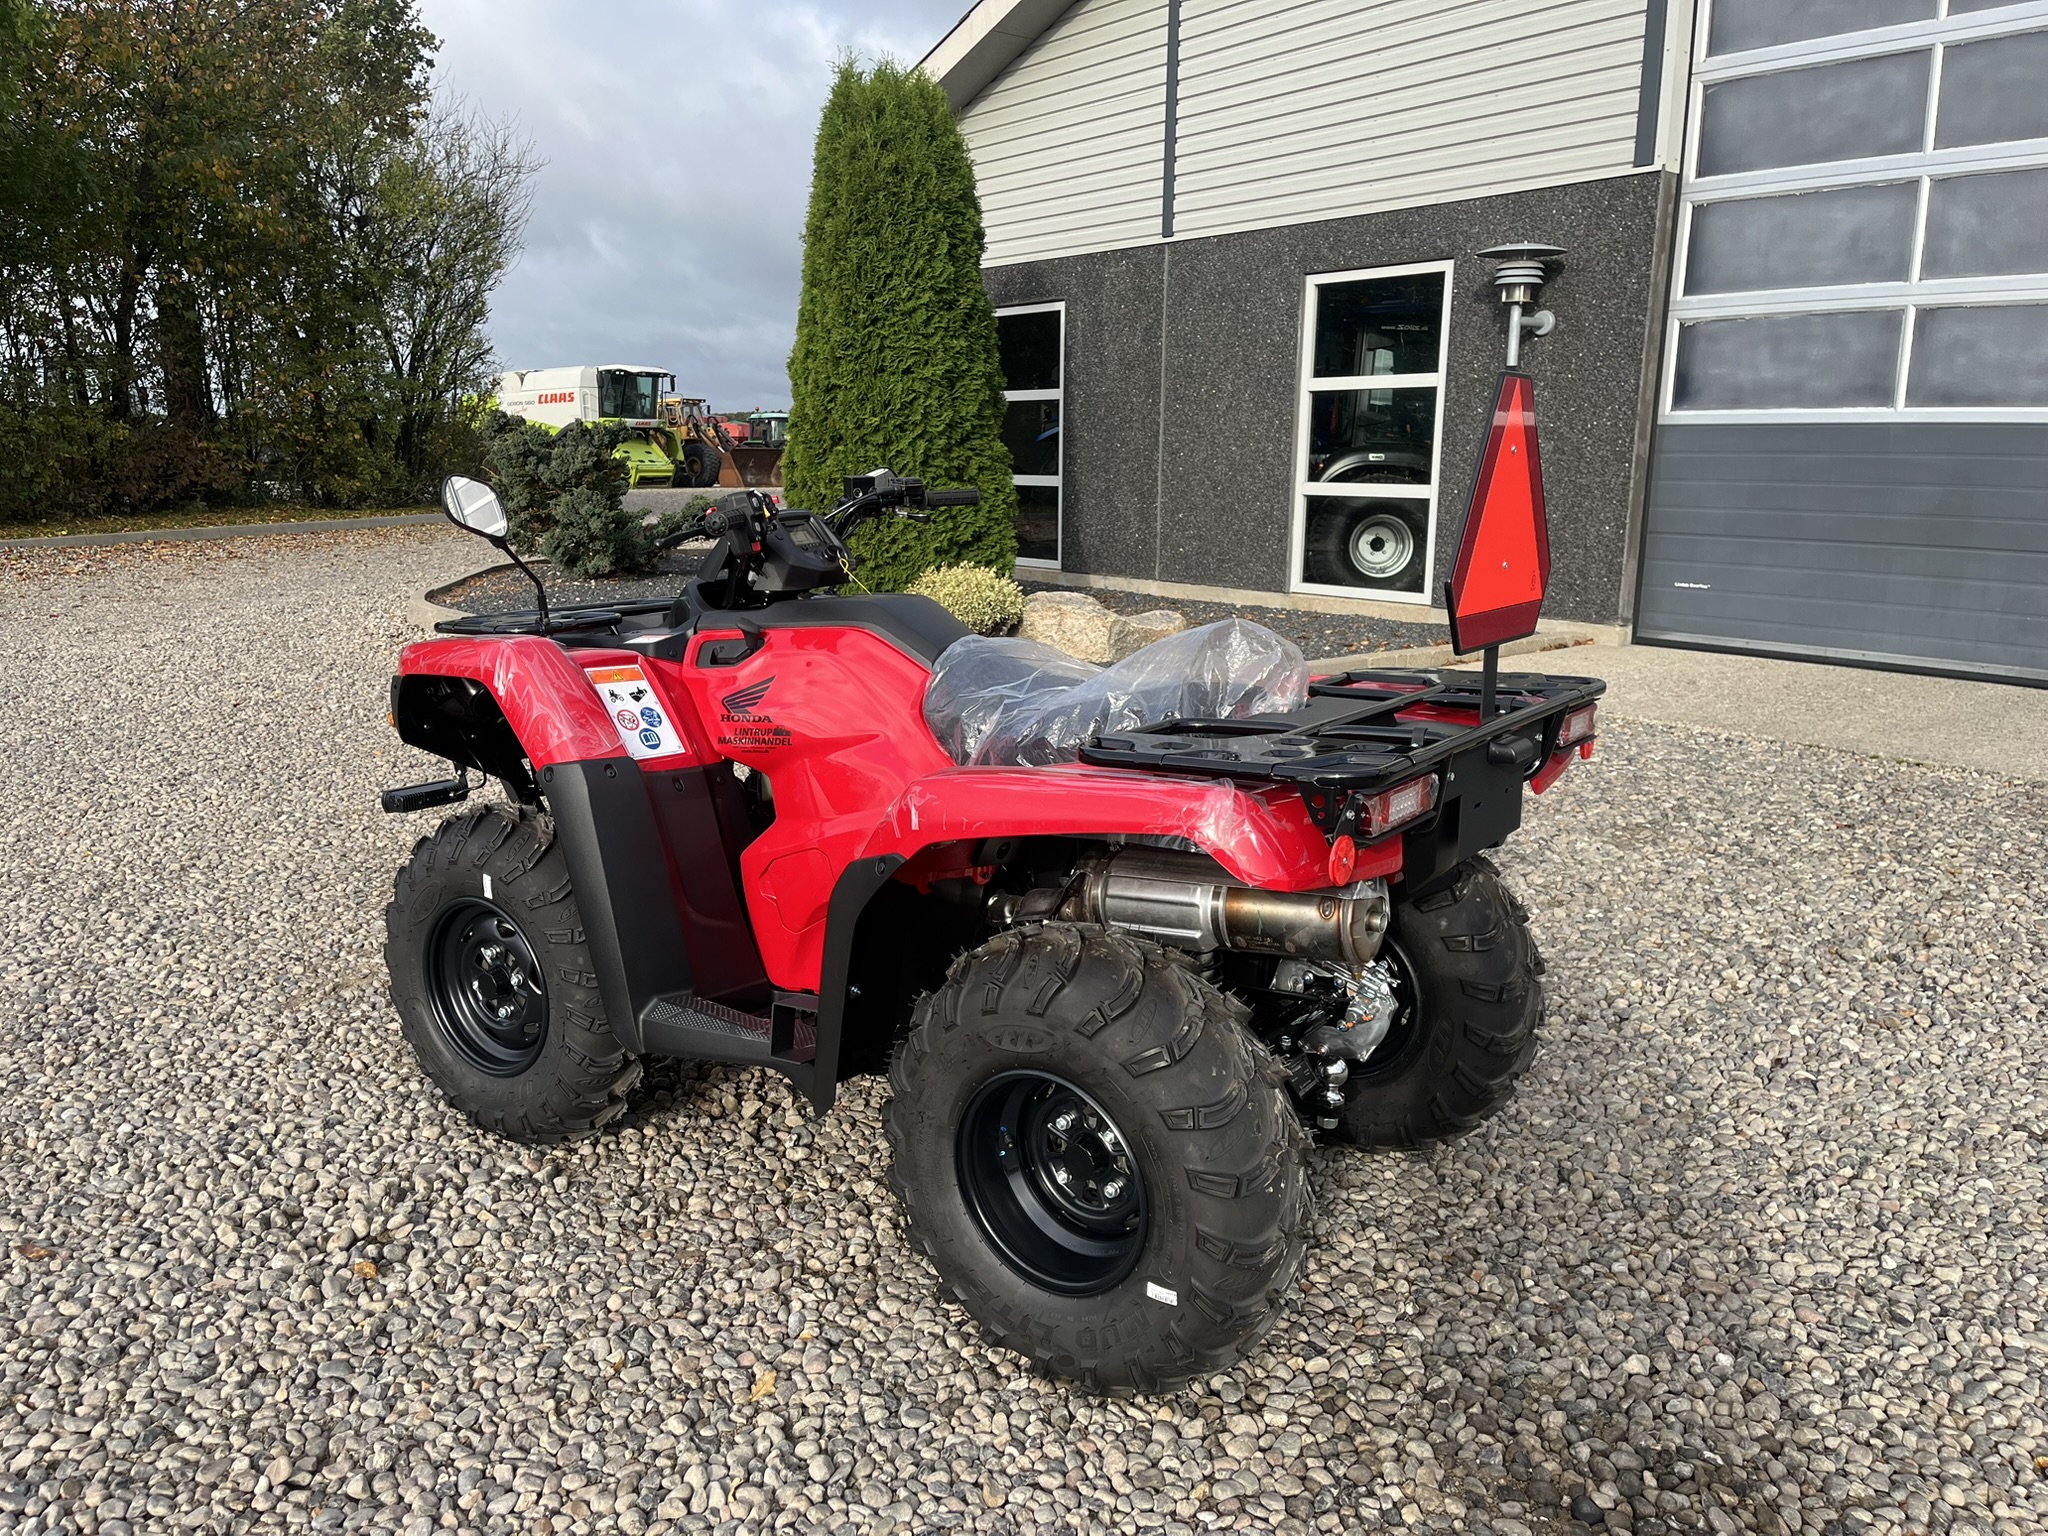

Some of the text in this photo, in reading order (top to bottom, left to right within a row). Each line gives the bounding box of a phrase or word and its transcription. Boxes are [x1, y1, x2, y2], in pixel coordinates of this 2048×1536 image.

[538, 391, 575, 405] CLAAS
[720, 714, 773, 723] HONDA
[734, 727, 773, 736] LINTRUP
[717, 736, 793, 746] MASKINHANDEL
